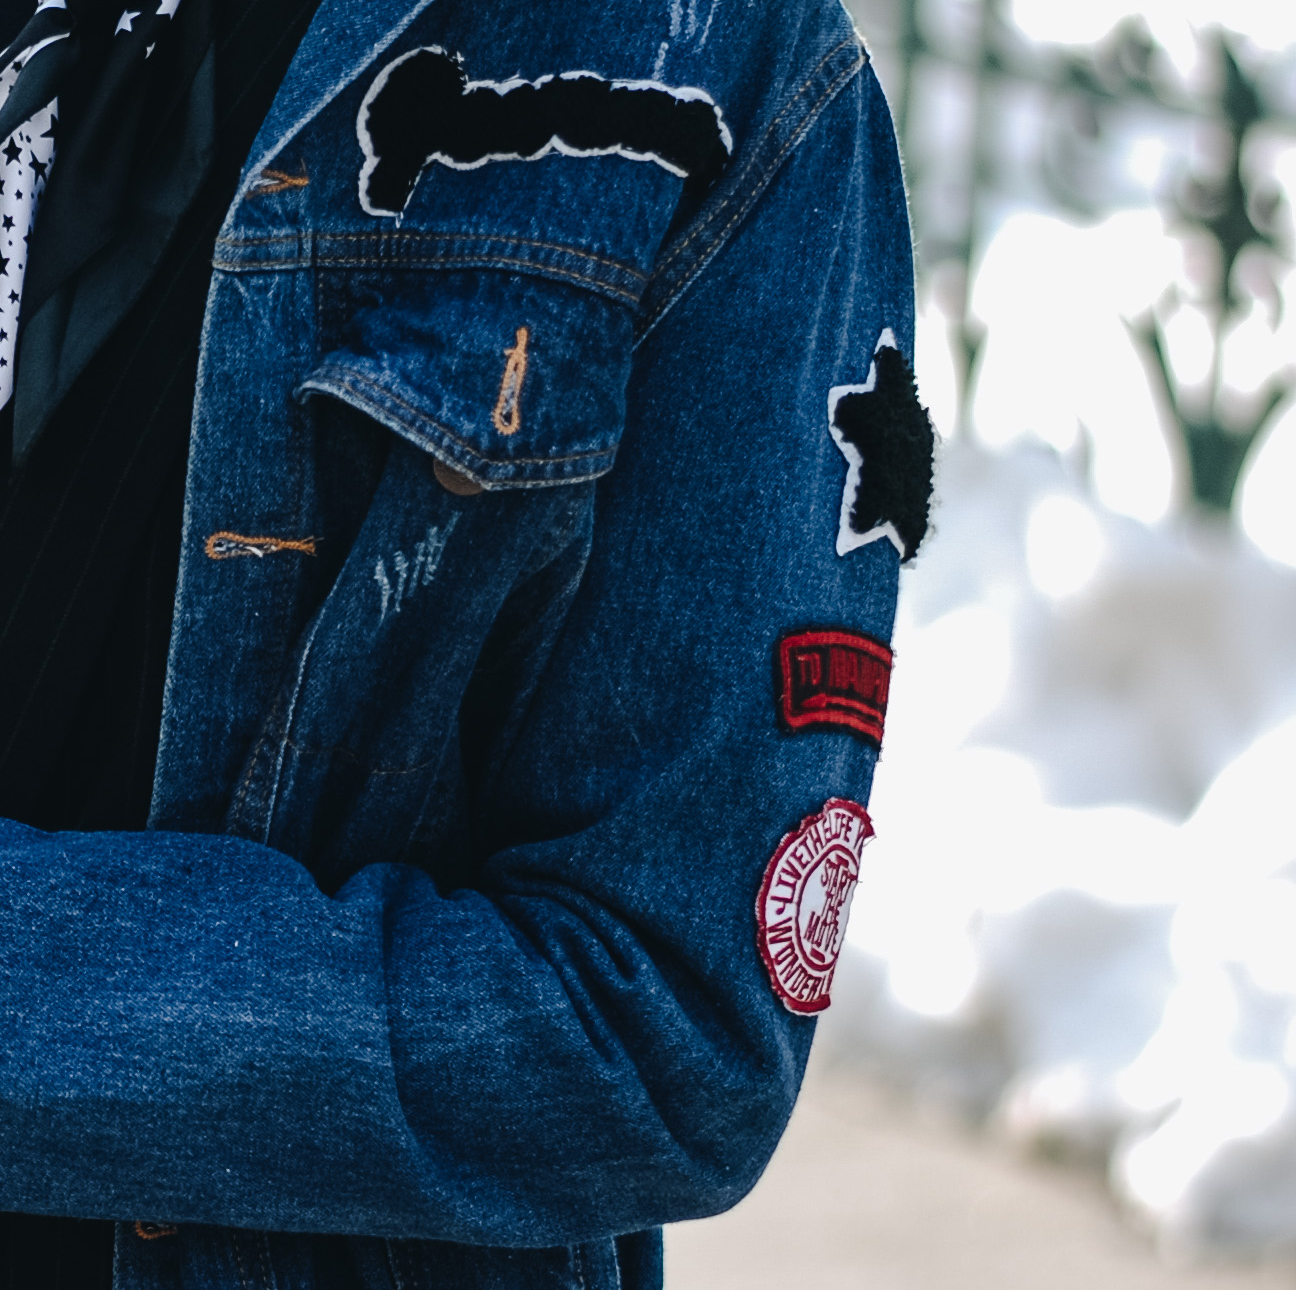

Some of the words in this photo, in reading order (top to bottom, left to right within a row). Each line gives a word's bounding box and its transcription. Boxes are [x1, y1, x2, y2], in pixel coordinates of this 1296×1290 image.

[770, 845, 811, 903] LIVE
[798, 818, 833, 860] THE
[819, 858, 858, 903] START
[804, 911, 839, 958] MOVE
